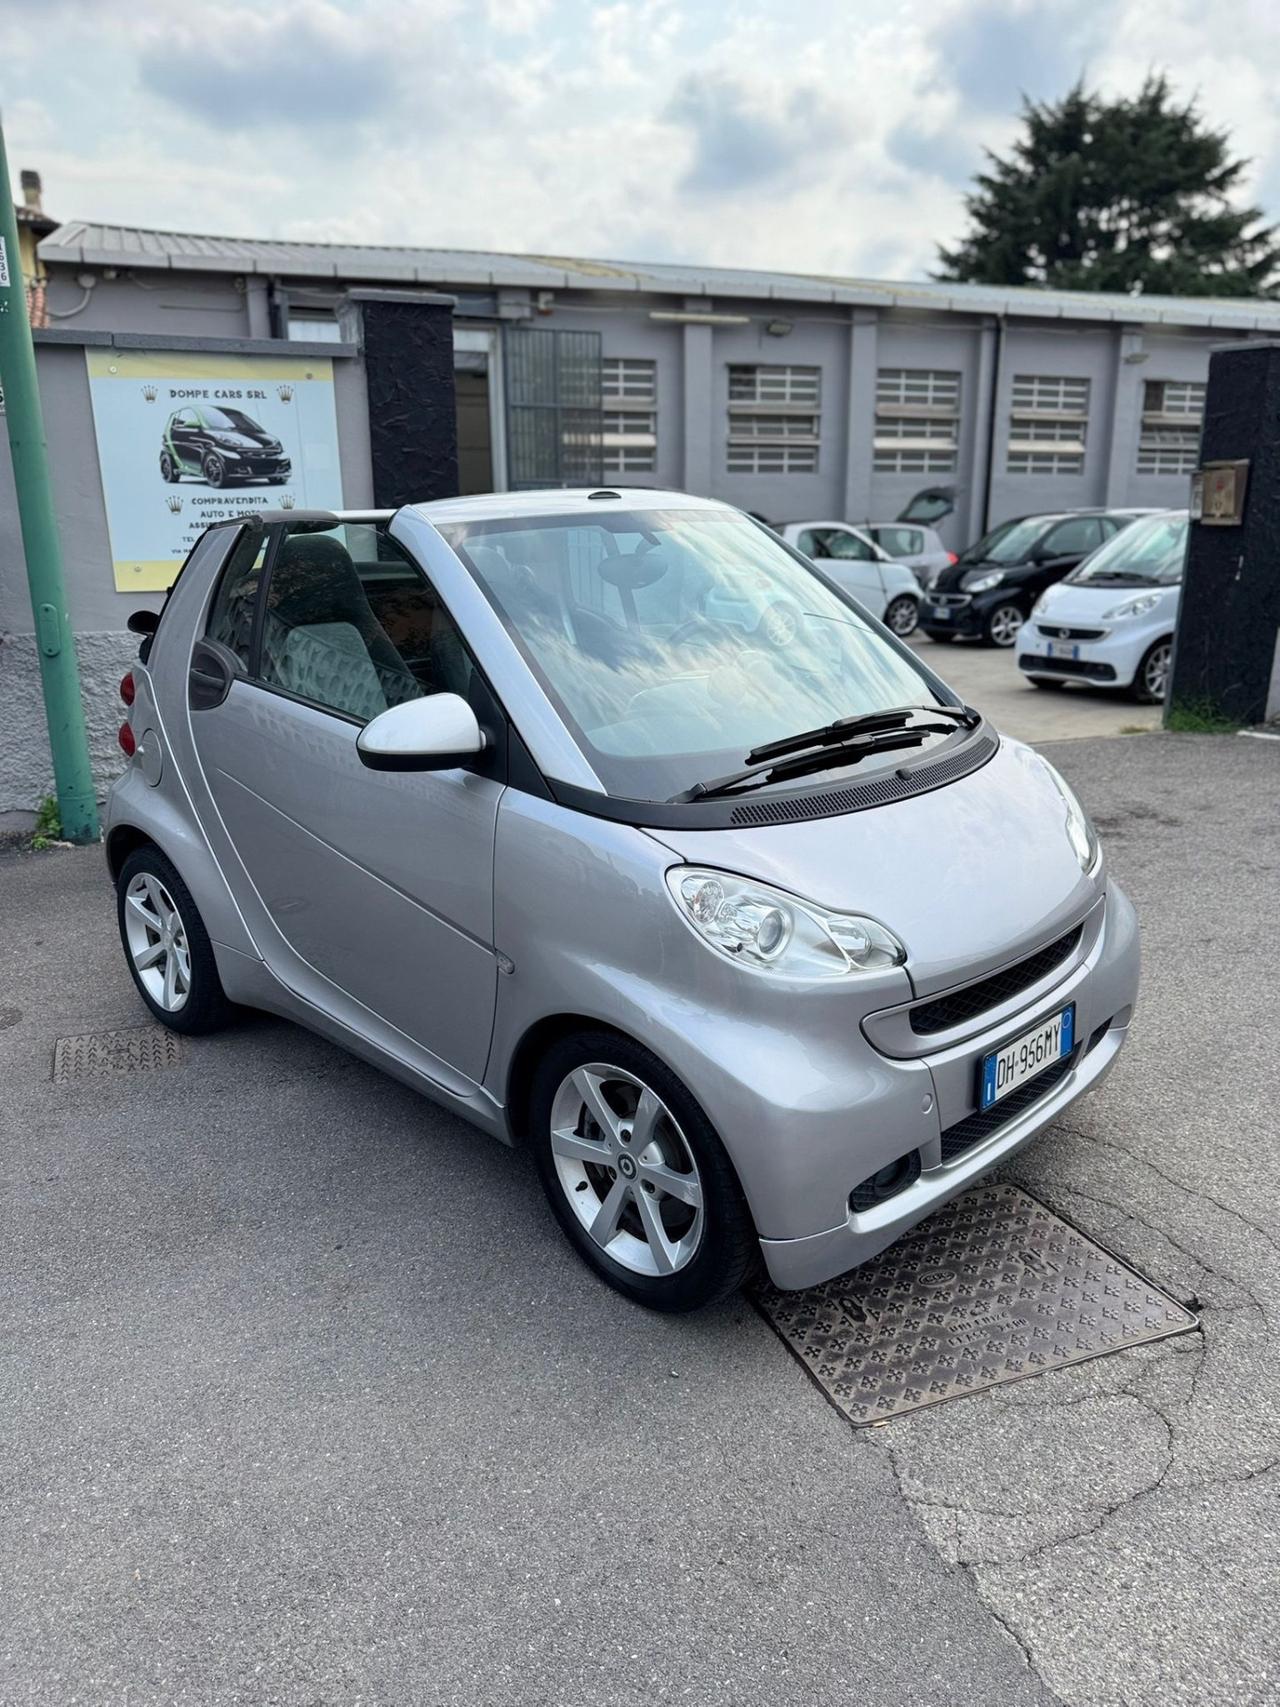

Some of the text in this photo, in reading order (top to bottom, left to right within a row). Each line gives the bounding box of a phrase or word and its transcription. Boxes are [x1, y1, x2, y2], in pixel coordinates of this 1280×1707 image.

[169, 389, 267, 399] DOMPE CARS SRL
[191, 497, 268, 505] COMPRAVENDITA
[228, 510, 234, 518] E
[237, 510, 260, 518] MOT
